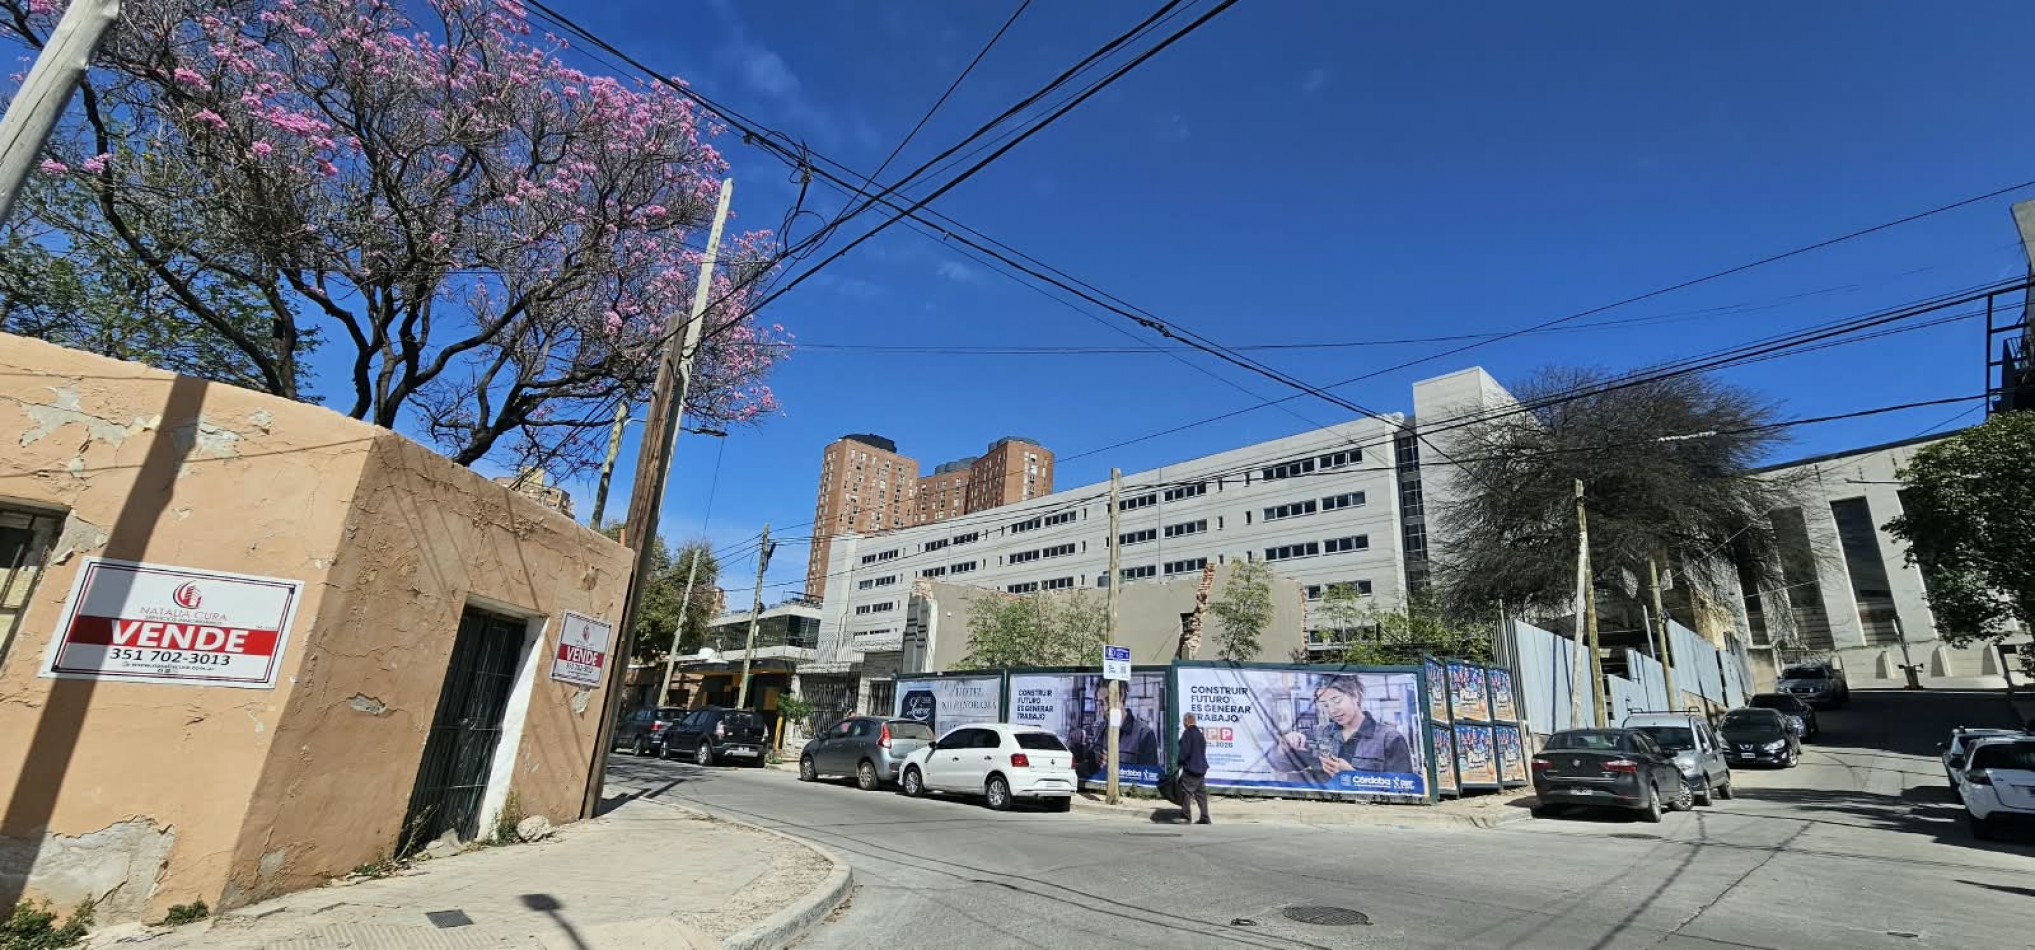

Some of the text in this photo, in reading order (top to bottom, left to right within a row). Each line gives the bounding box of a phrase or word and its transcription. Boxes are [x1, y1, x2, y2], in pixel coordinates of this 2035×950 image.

[139, 606, 228, 621] NATALIA CURA
[112, 620, 249, 653] VENDE
[109, 648, 231, 666] 351 702-3013
[566, 646, 599, 666] VENDE
[955, 687, 984, 697] HOTEL
[1018, 688, 1053, 697] CONSTRUIR
[1191, 686, 1248, 695] CONSTRUIR
[1191, 695, 1230, 703] FUTURO
[1191, 704, 1251, 714] ES GENERAR
[1017, 712, 1045, 720] TRABAJO
[1352, 776, 1391, 786] Córdoba
